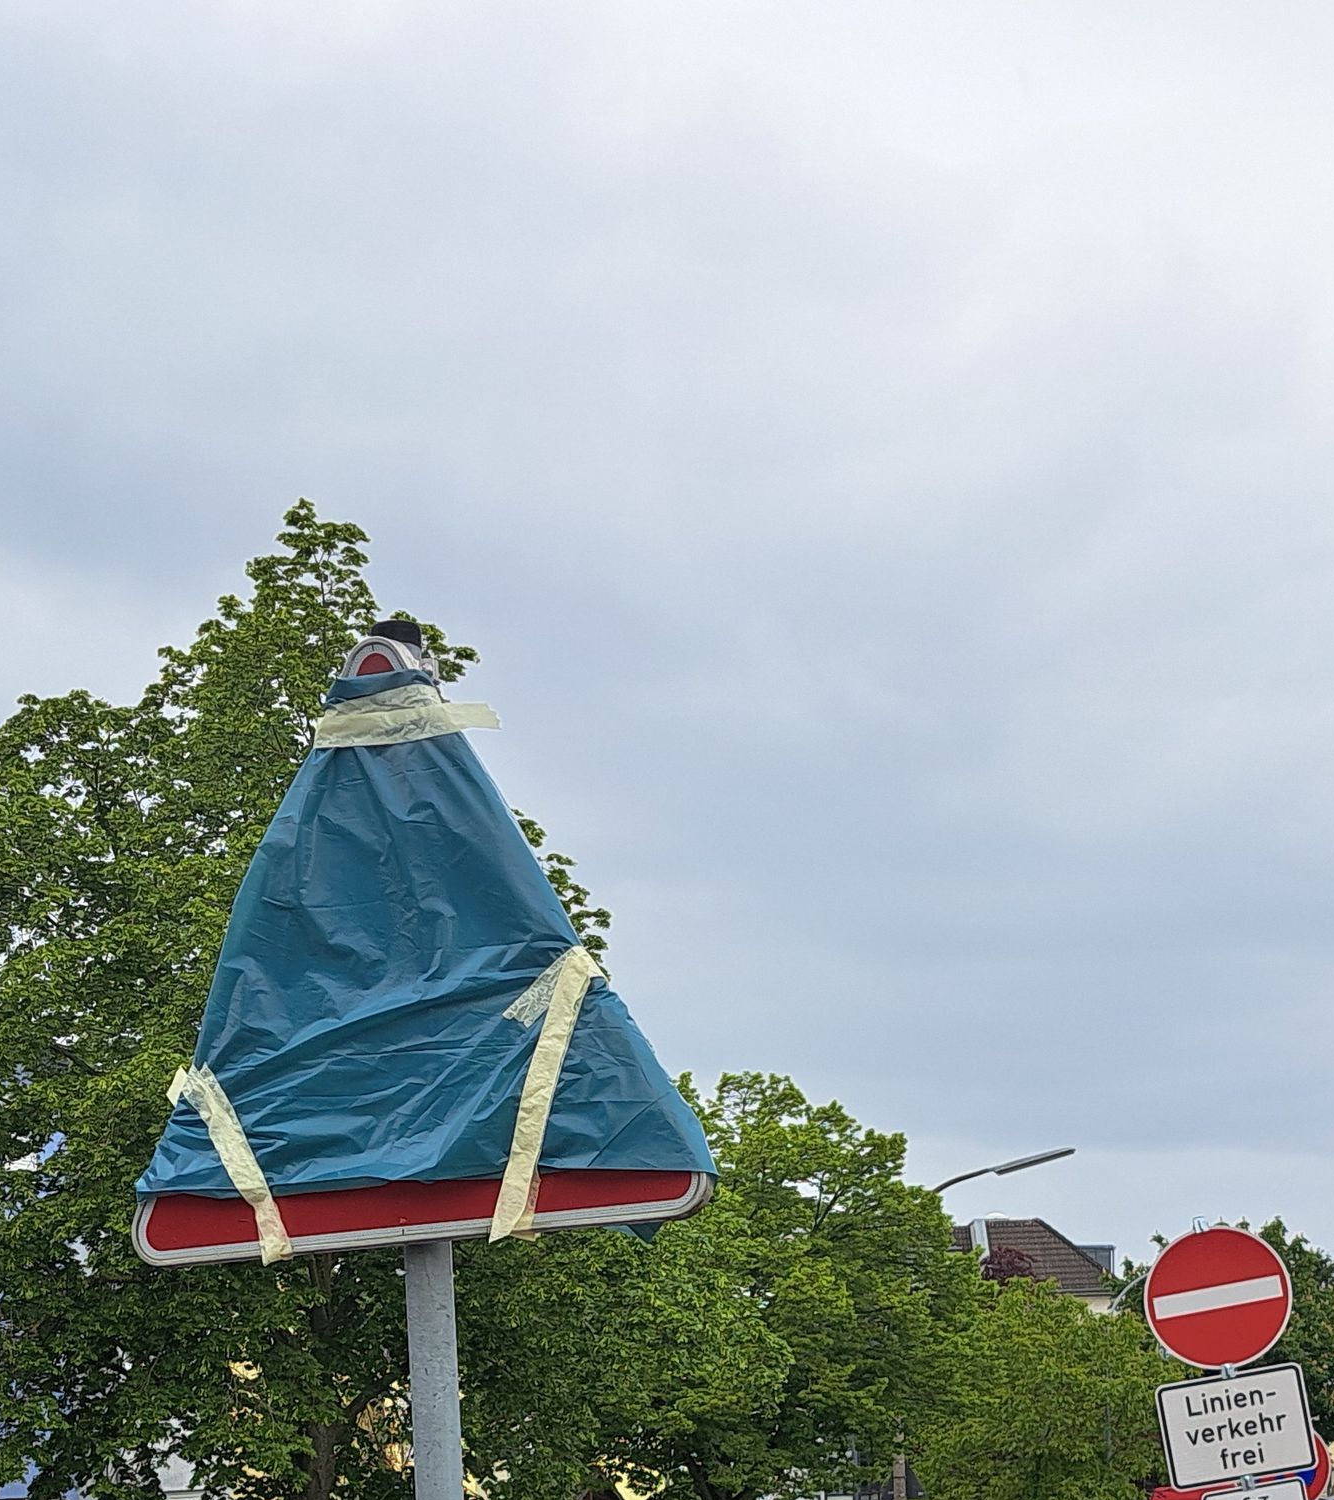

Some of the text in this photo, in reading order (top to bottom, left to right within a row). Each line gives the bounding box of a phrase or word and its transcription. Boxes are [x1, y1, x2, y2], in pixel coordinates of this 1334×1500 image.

[1185, 1388, 1276, 1418] Linien-
[1186, 1412, 1287, 1446] verkehr
[1220, 1443, 1266, 1470] frei
